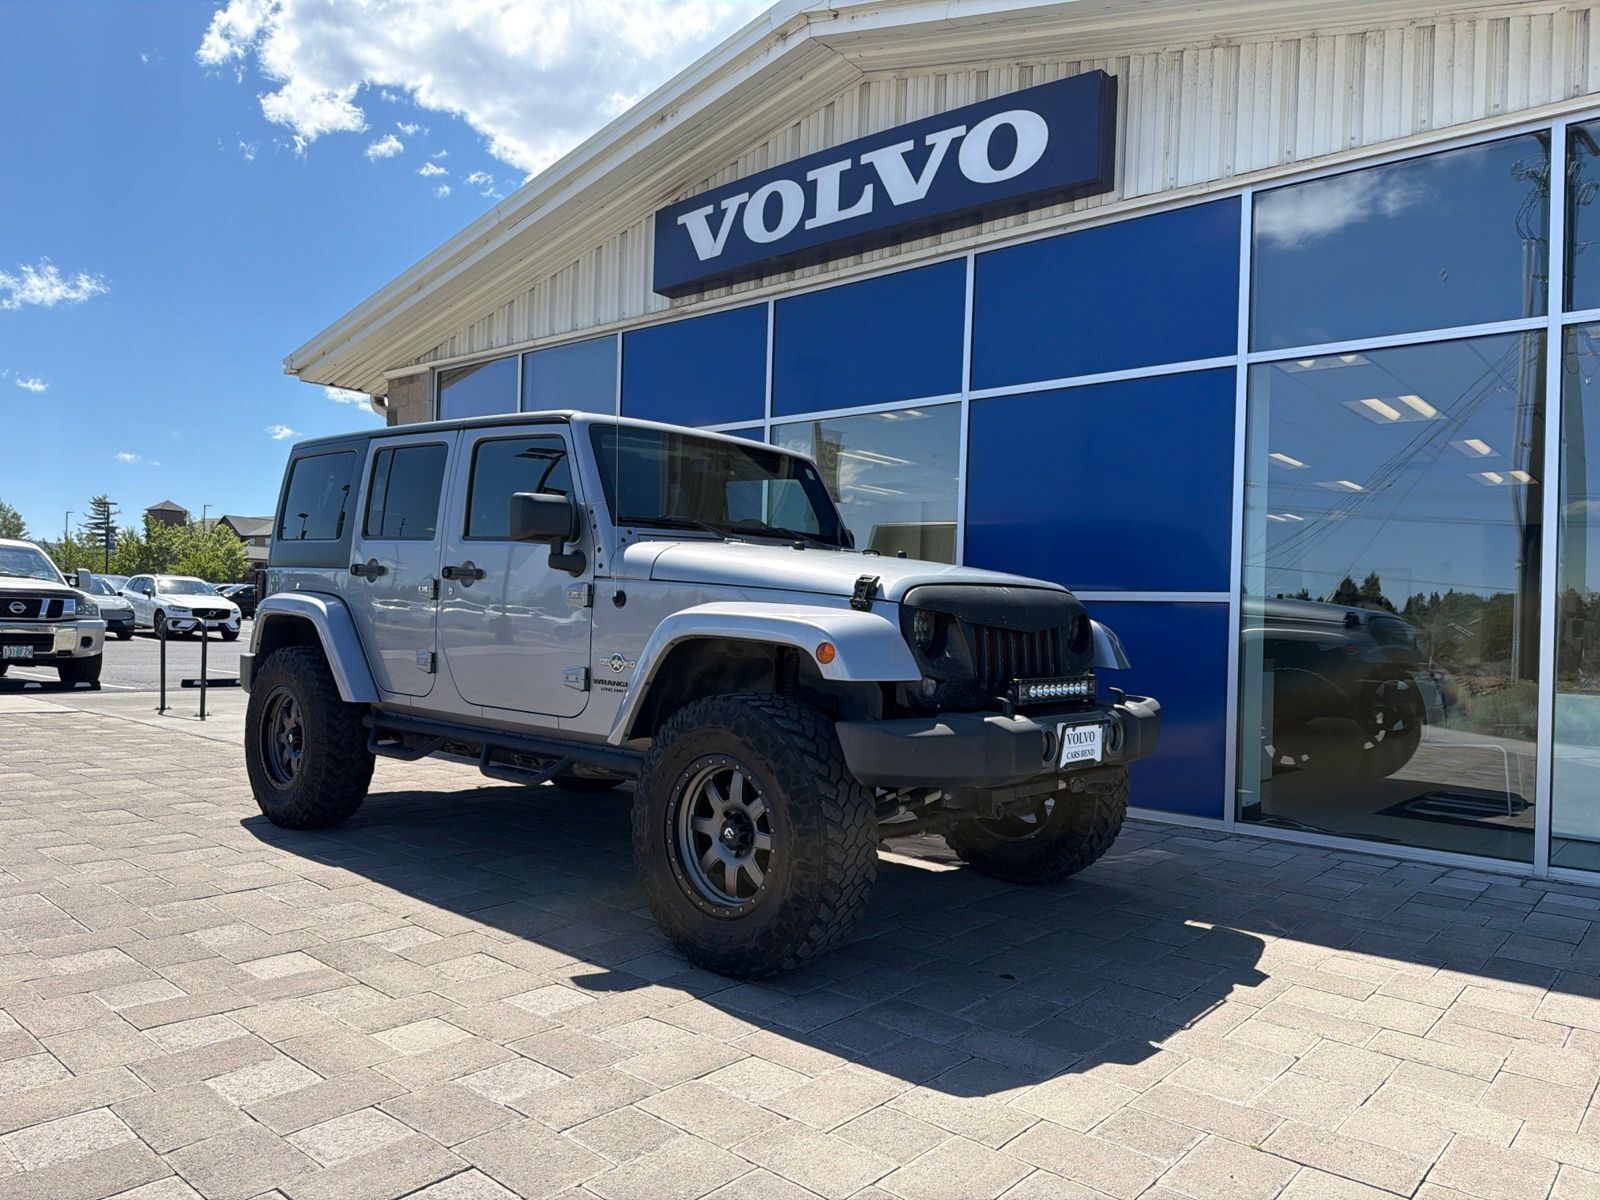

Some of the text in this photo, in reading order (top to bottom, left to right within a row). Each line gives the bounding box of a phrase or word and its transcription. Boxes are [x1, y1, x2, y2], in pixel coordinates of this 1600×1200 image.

[677, 109, 1049, 262] VOLVO
[1066, 731, 1096, 745] VOLVO
[1066, 748, 1096, 760] CARS BEND
